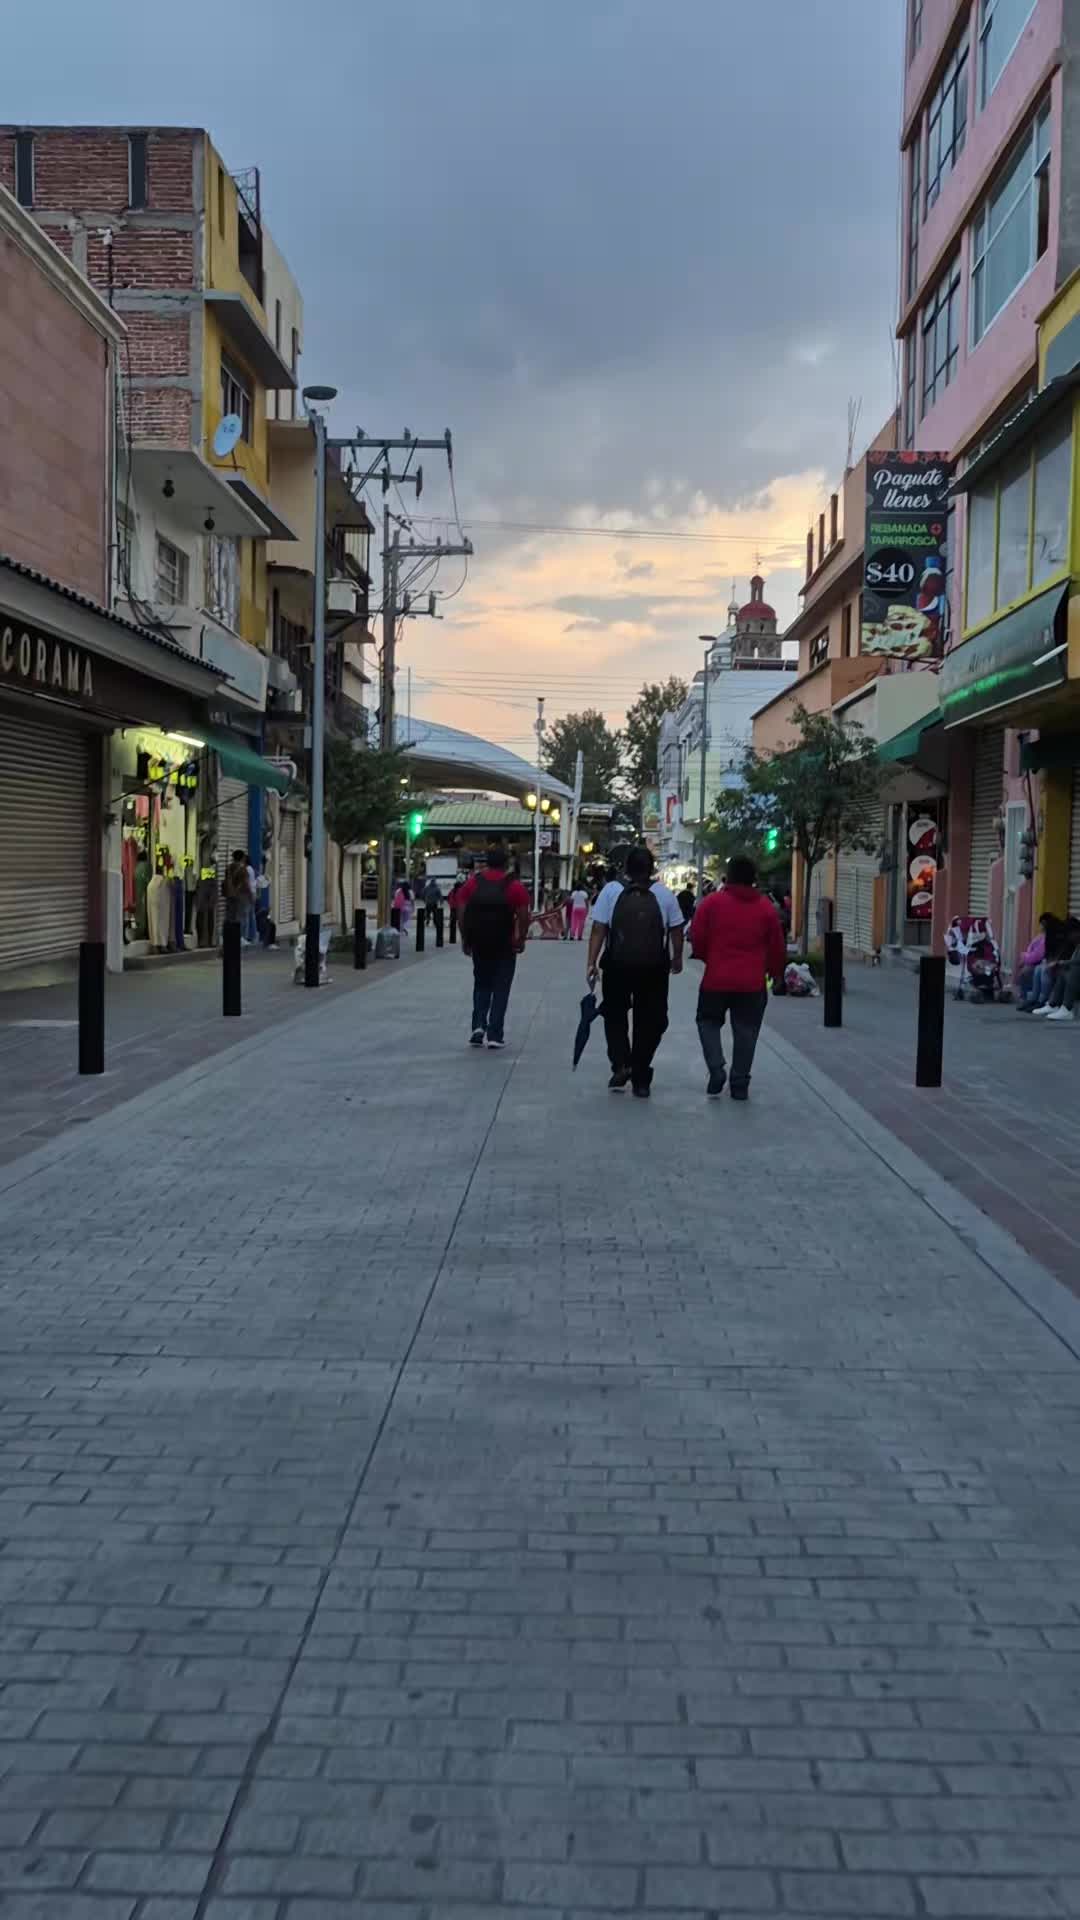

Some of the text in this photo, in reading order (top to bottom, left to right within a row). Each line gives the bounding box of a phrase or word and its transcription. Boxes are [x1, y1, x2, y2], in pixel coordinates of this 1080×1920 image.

[873, 468, 944, 490] Paquete
[883, 488, 932, 509] llenes
[870, 523, 928, 534] REBANADA
[870, 535, 937, 546] TAPARROSCA
[866, 561, 915, 583] $40
[1, 626, 93, 697] CORAMA
